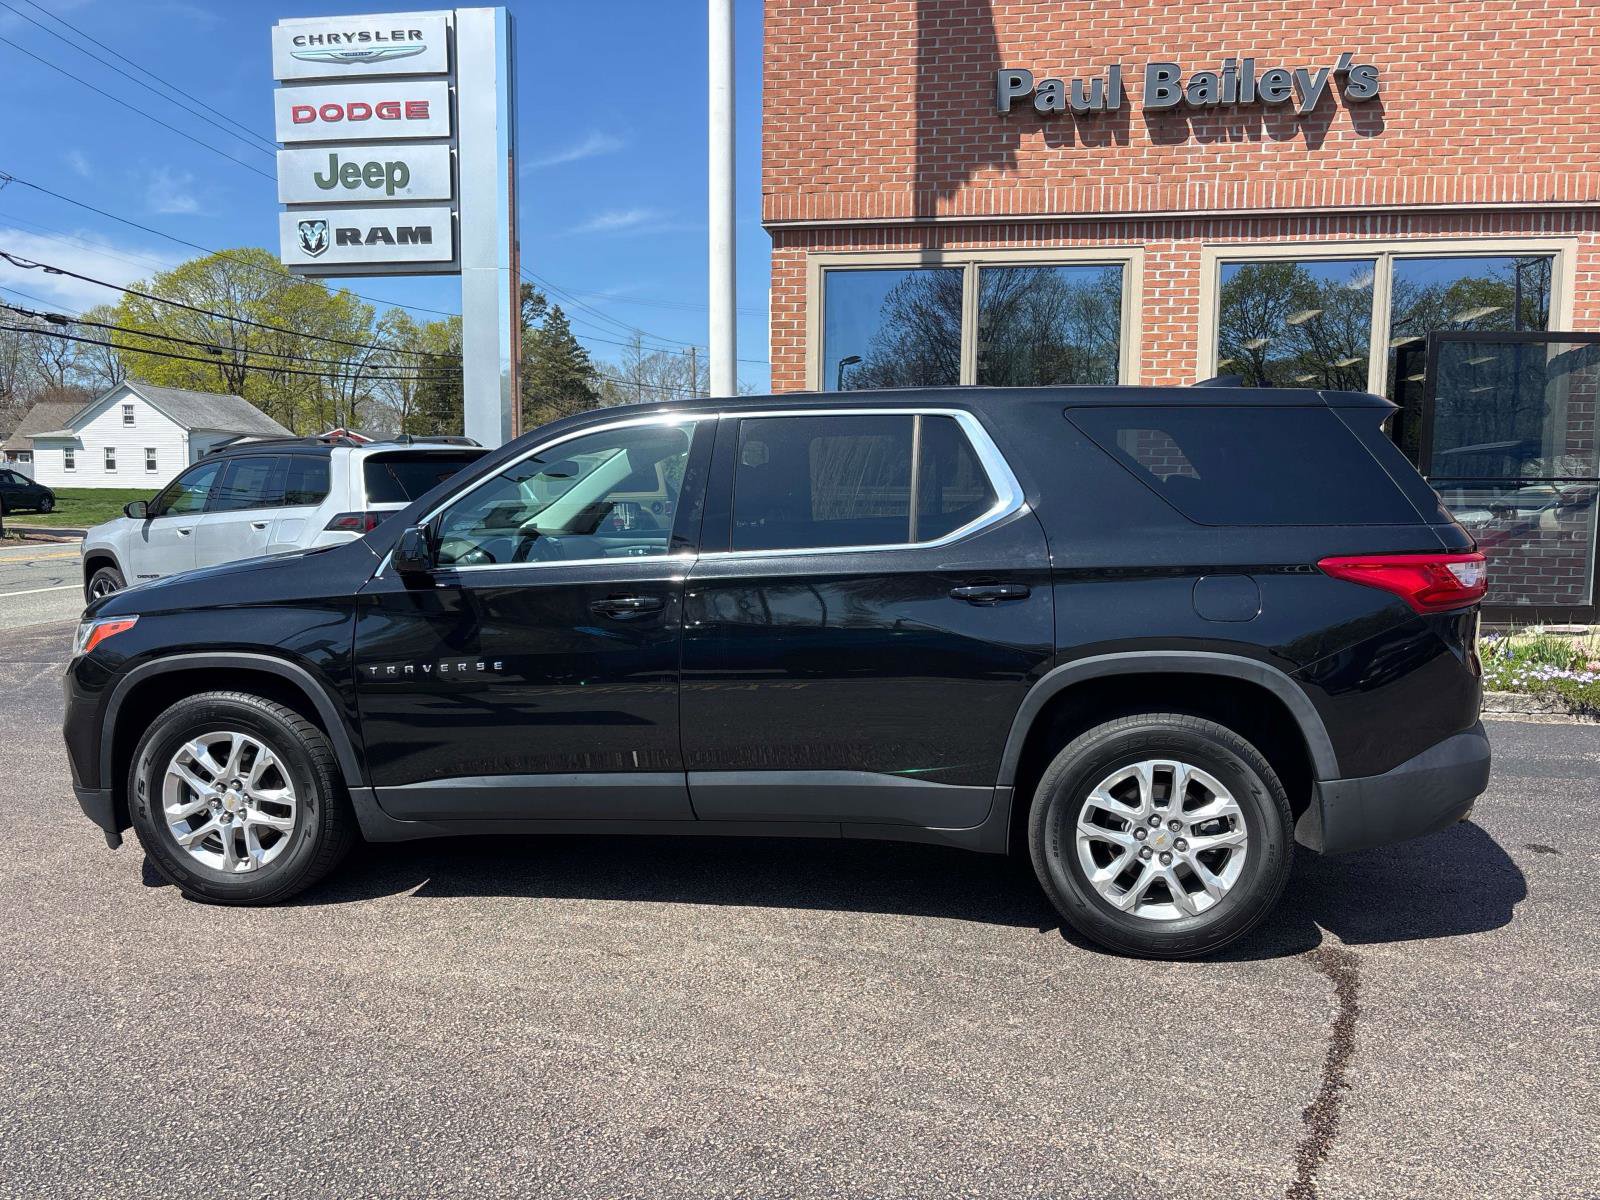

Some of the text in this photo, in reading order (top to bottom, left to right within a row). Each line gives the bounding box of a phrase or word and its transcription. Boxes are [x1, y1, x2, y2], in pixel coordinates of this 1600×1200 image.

[292, 29, 424, 47] CHRYSLER
[997, 52, 1381, 114] Paul Bailey's
[291, 100, 430, 124] DODGE
[313, 153, 411, 196] Jeep
[335, 225, 433, 246] RAM
[369, 661, 503, 675] TRAVERSE
